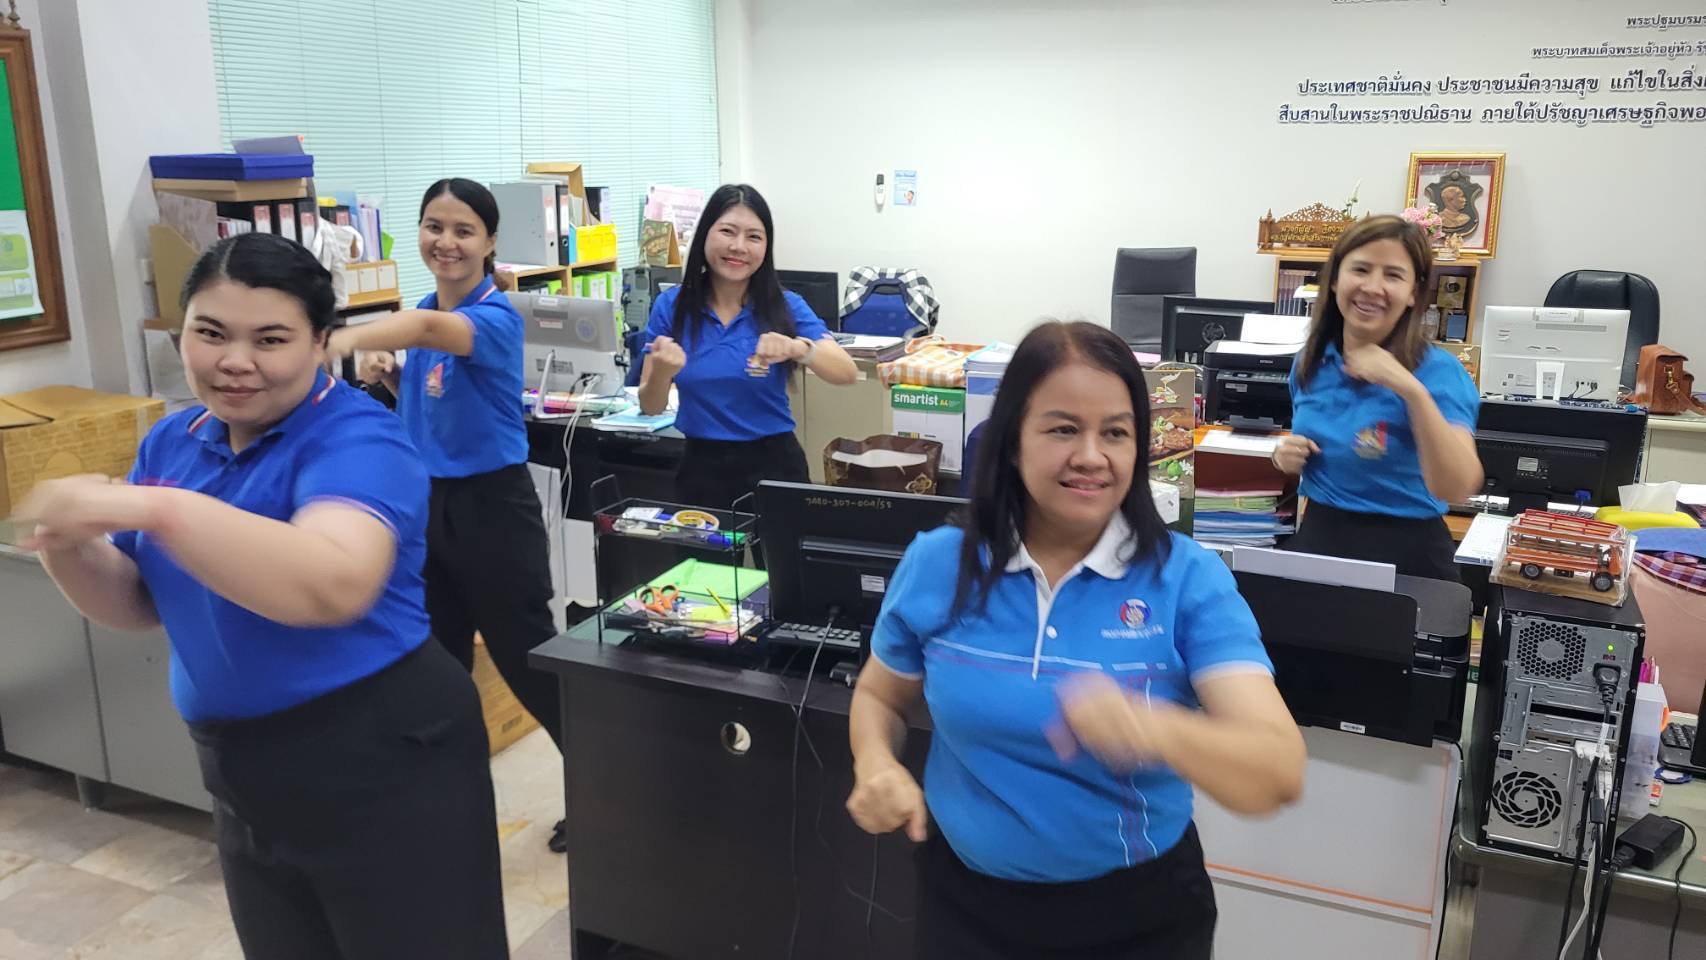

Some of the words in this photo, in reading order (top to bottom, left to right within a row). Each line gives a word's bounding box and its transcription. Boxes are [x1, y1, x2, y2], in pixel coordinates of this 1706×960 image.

[1298, 71, 1431, 94] ประเทศชาติมั่นคง
[1437, 72, 1598, 97] ประชาชนมีความสุข
[1610, 65, 1706, 90] แก้ไขในสิ่ง
[1279, 103, 1472, 122] สืบสานในพระราชปณิธาน
[894, 393, 938, 406] smartist
